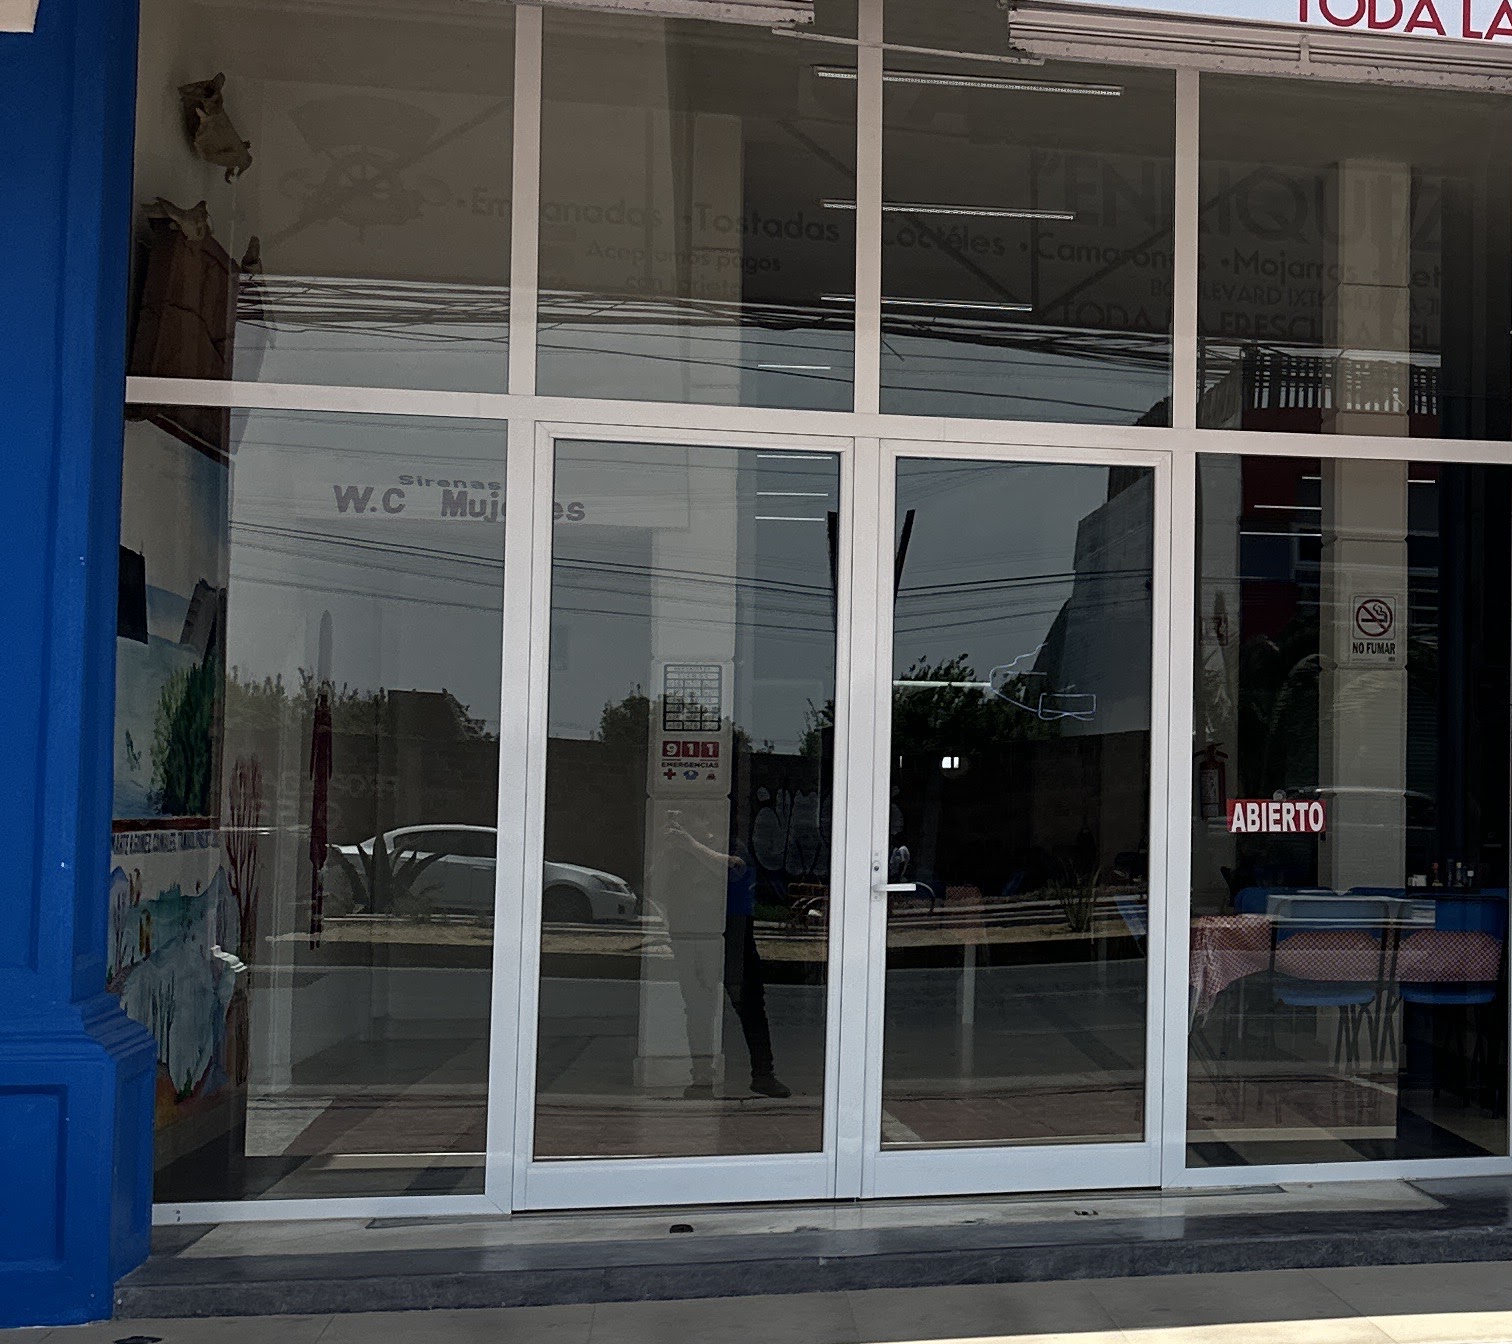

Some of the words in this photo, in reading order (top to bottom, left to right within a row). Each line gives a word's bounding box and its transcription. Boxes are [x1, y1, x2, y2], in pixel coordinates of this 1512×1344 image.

[1352, 642, 1364, 654] NO
[1366, 642, 1395, 654] FUMAR
[665, 742, 715, 757] 911
[661, 761, 719, 769] EMERGENCIAS
[1231, 801, 1325, 832] ABIERTO
